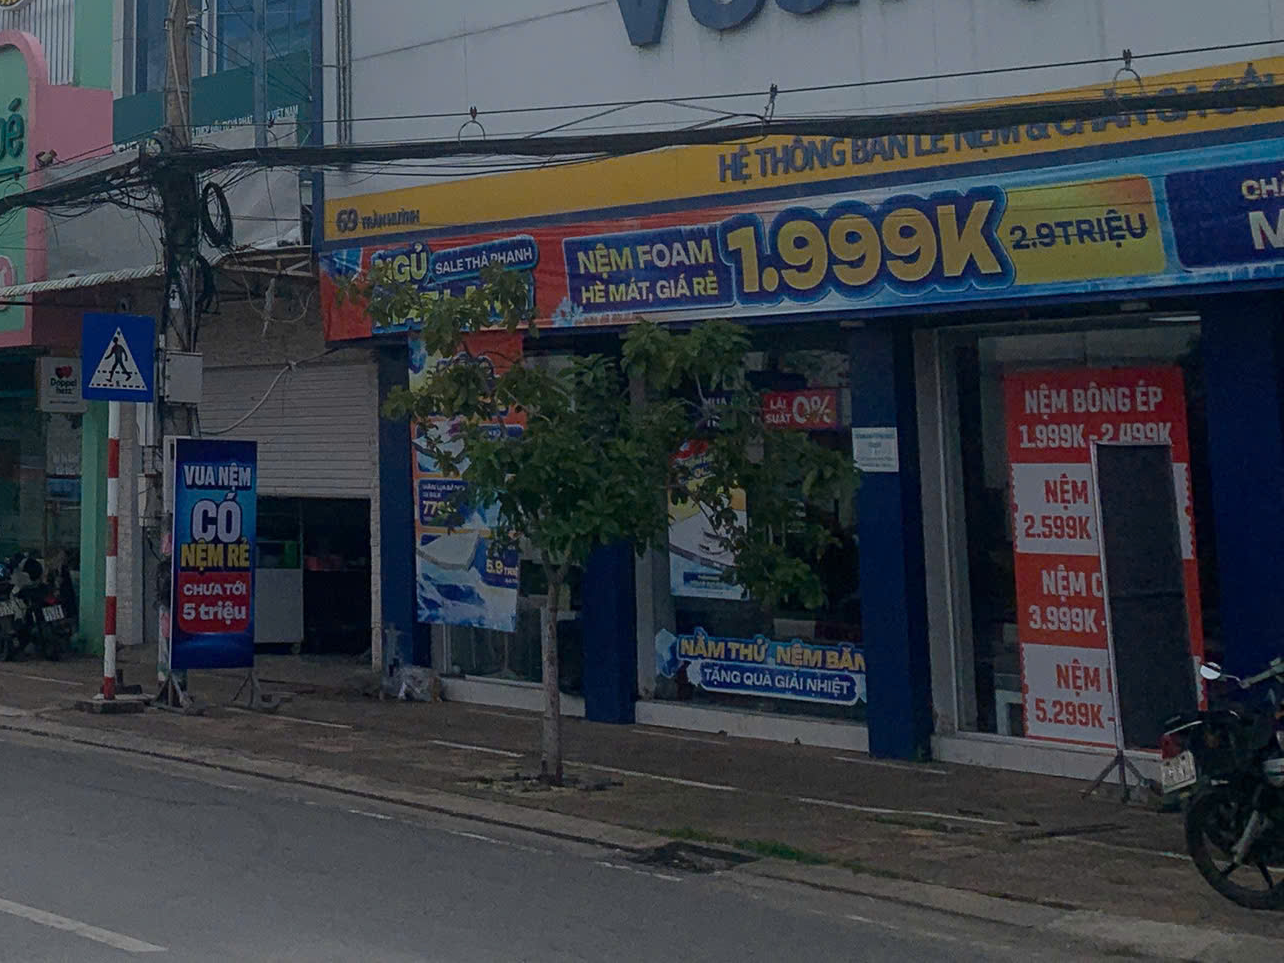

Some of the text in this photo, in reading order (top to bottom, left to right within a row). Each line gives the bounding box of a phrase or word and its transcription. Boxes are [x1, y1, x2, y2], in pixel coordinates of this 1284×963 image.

[718, 144, 752, 185] HỆ
[1241, 170, 1284, 200] CH
[435, 258, 465, 274] SALE
[465, 251, 489, 270] THẢ
[577, 238, 714, 279] NỆM FOAM
[727, 199, 1002, 294] 1.999K
[581, 269, 719, 304] HÈ MÁT, GIÁ RẺ
[50, 377, 78, 388] Doppel
[1024, 379, 1164, 420] NỆM BÔNG ÉP
[1019, 423, 1087, 449] 1.999K
[184, 463, 251, 492] VUA NỆM
[1044, 472, 1090, 511] NỆM
[192, 492, 242, 544] CÓ
[1023, 514, 1092, 541] 2.599K
[181, 539, 224, 571] NỆM
[183, 580, 247, 596] CHƯA TỚI
[1041, 564, 1087, 603] NỆM
[182, 600, 247, 625] 5 triệu
[1029, 604, 1098, 634] 3.999K
[704, 667, 851, 699] TẶNG QUÀ GIẢI NHIỆT
[1056, 657, 1102, 698] NỆM
[1034, 697, 1105, 730] 5.299K
